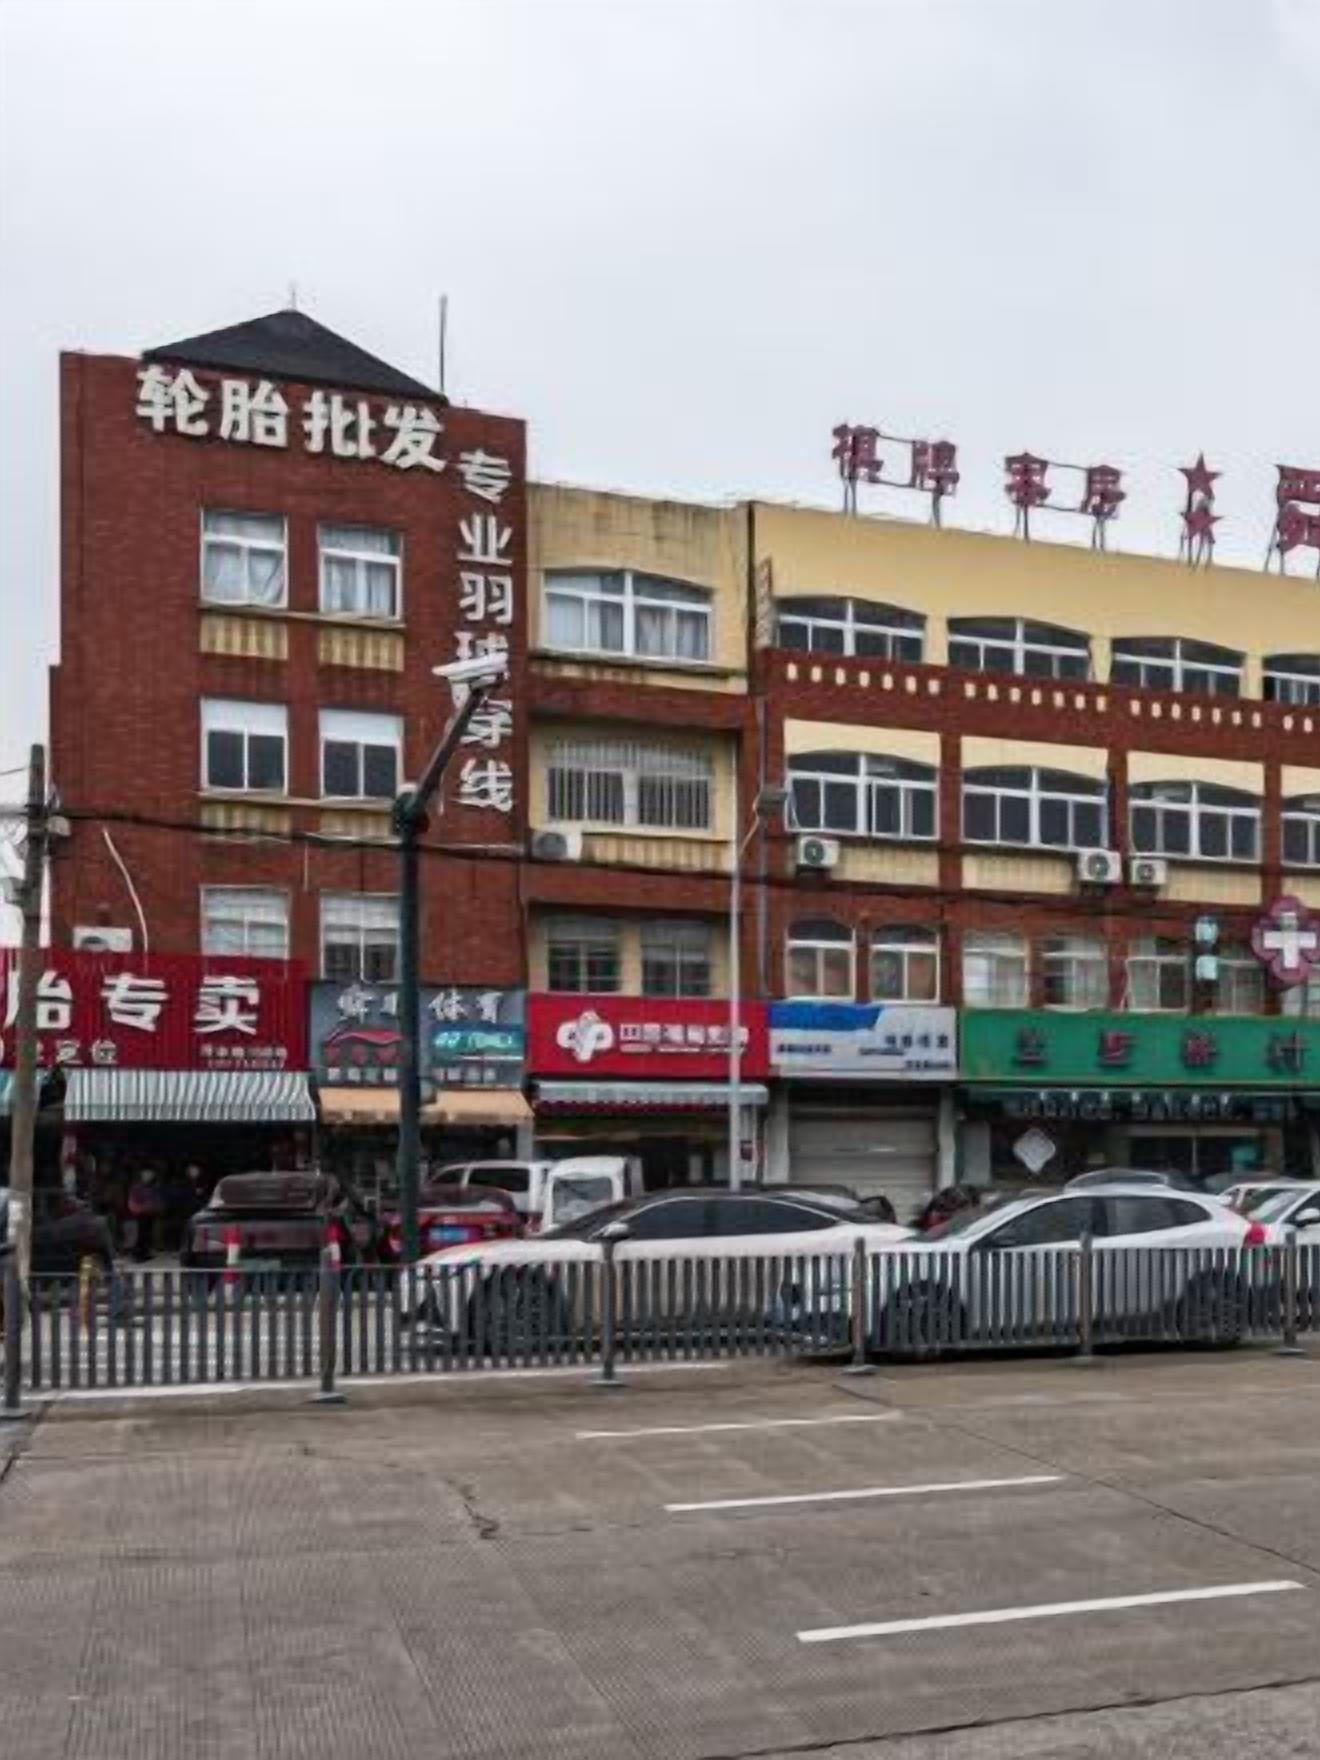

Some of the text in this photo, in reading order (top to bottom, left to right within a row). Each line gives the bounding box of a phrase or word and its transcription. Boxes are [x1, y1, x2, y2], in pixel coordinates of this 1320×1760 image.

[135, 366, 446, 473] 轮胎批发
[1005, 451, 1127, 520] 客房
